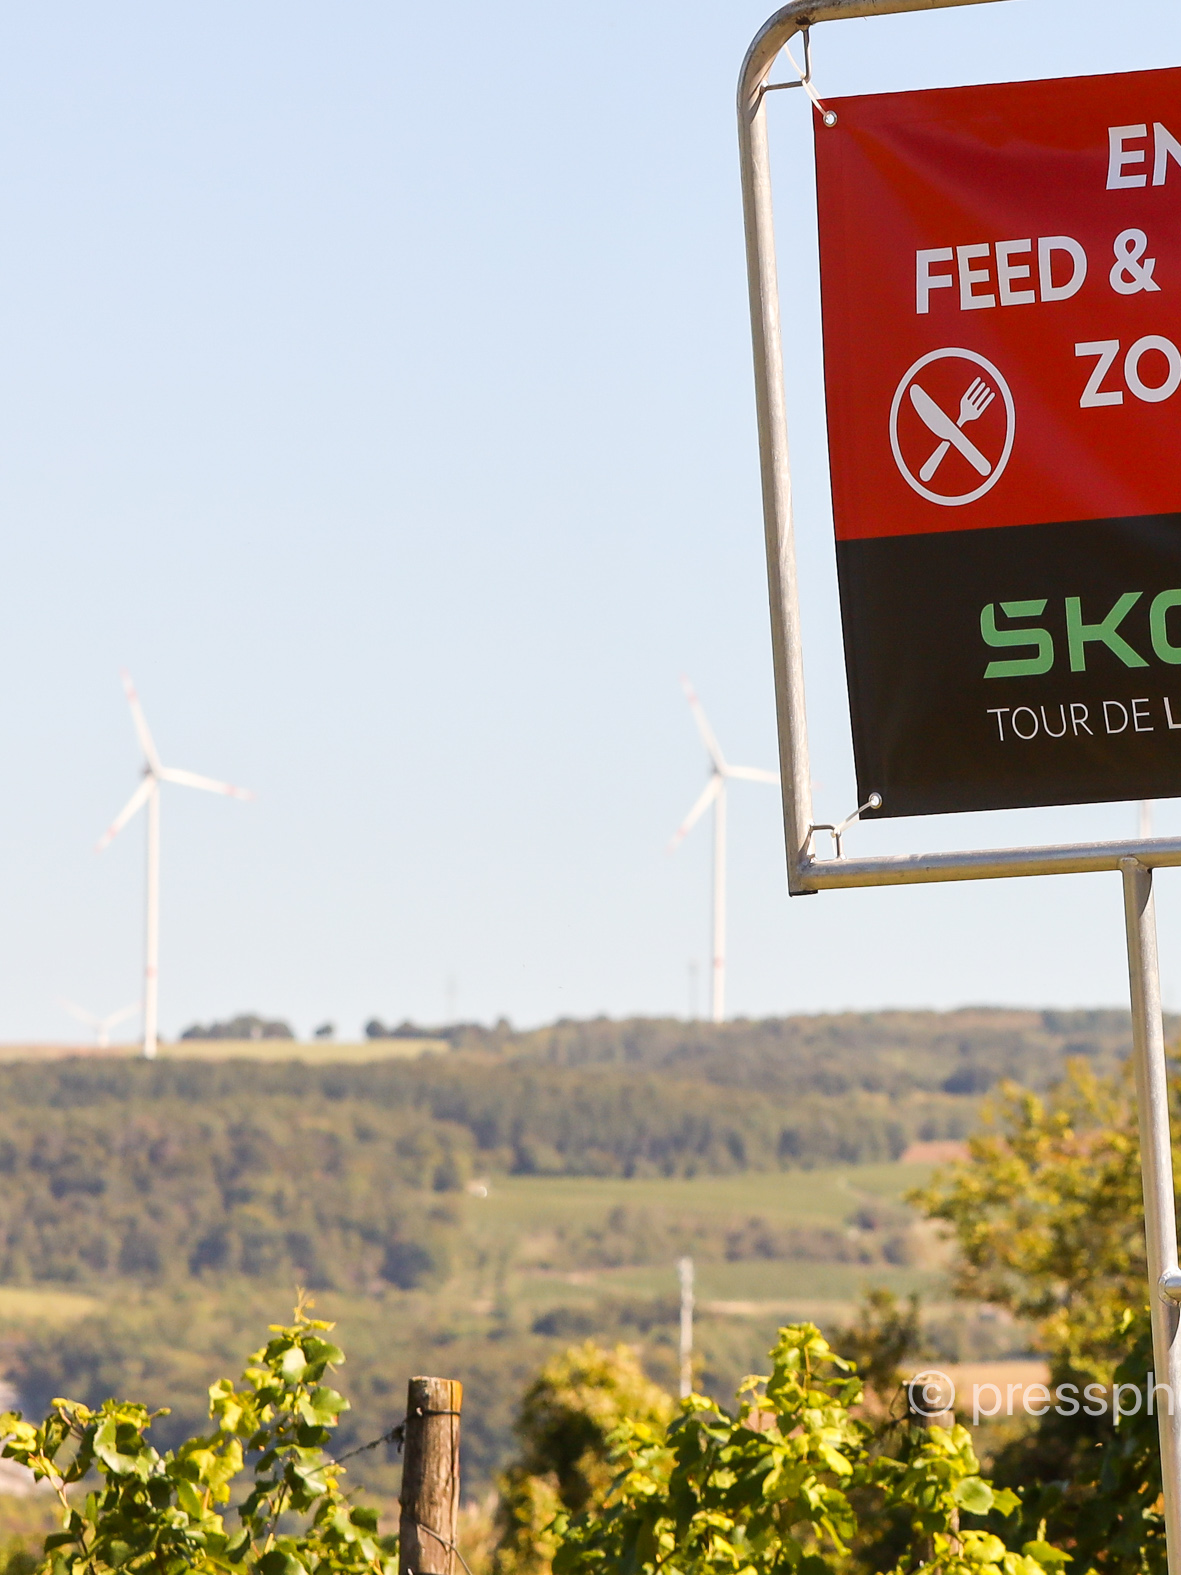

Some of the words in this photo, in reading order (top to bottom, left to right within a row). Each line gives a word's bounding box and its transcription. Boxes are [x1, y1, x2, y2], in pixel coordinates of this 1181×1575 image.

[915, 235, 1088, 315] FEED
[1109, 228, 1162, 295] &
[986, 702, 1094, 742] TOUR
[1102, 697, 1154, 734] DE
